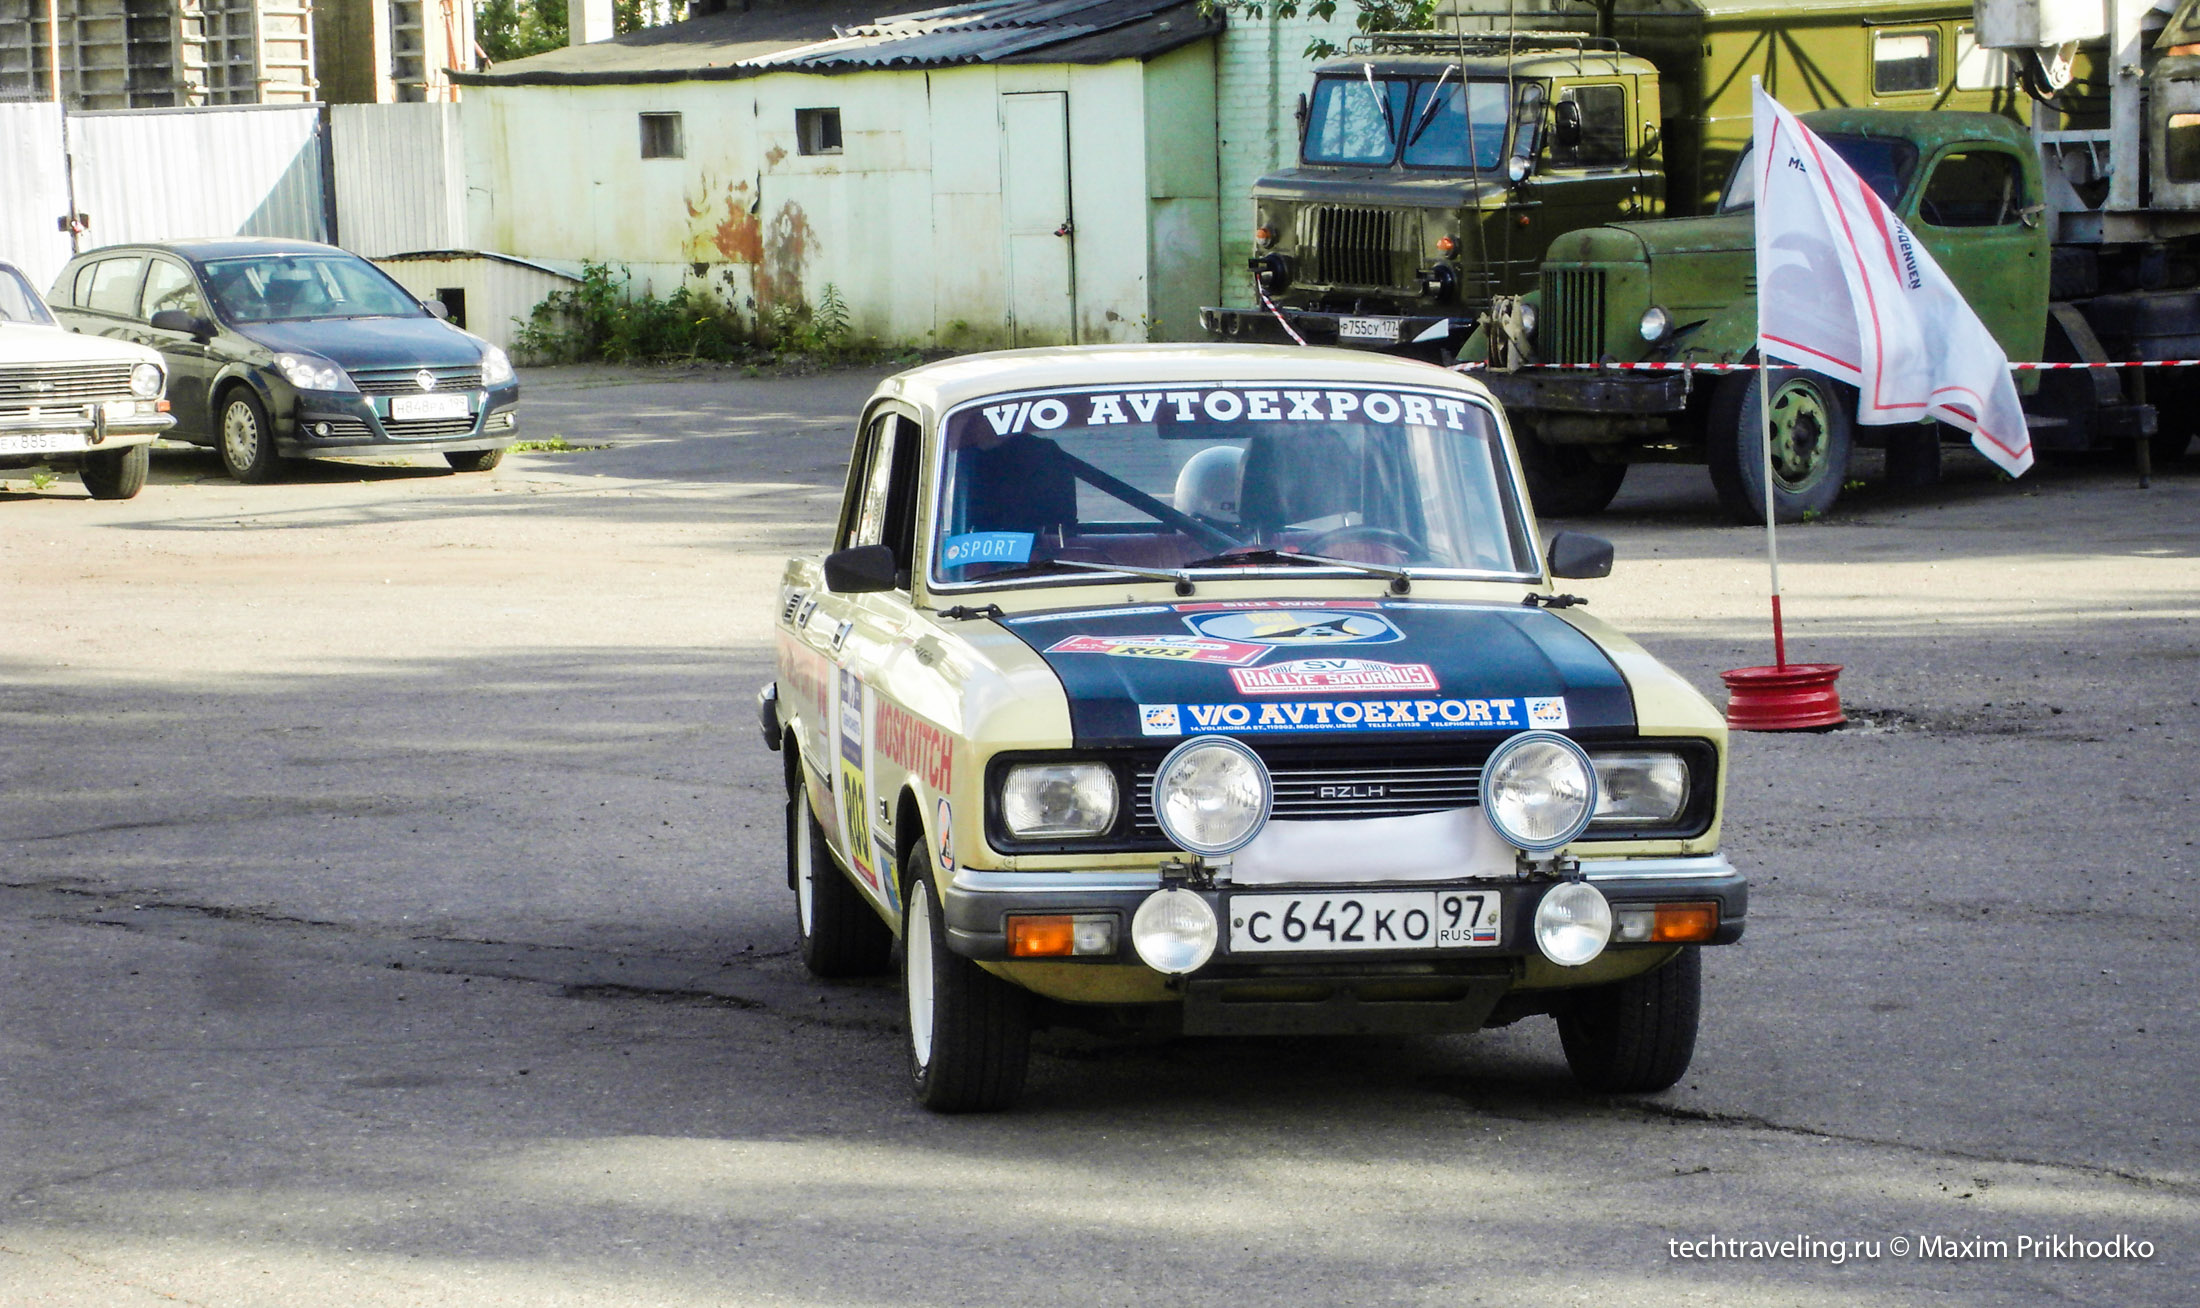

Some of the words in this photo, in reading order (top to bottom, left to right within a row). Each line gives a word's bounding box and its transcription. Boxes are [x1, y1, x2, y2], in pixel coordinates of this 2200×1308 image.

[1381, 320, 1397, 332] 177
[983, 398, 1070, 436] V/O
[1087, 390, 1466, 431] AVTOEXPORT
[960, 539, 1017, 559] SPORT
[1303, 659, 1348, 670] SV
[1242, 670, 1319, 687] RALLYE
[1326, 666, 1426, 685] SATURNUS
[1187, 703, 1251, 726] V/O
[1258, 698, 1516, 724] AVTOEXPORT
[875, 698, 954, 795] MOSKVITCH
[1319, 785, 1385, 798] AZLH
[1443, 895, 1485, 929] 97
[1440, 928, 1472, 941] RUS
